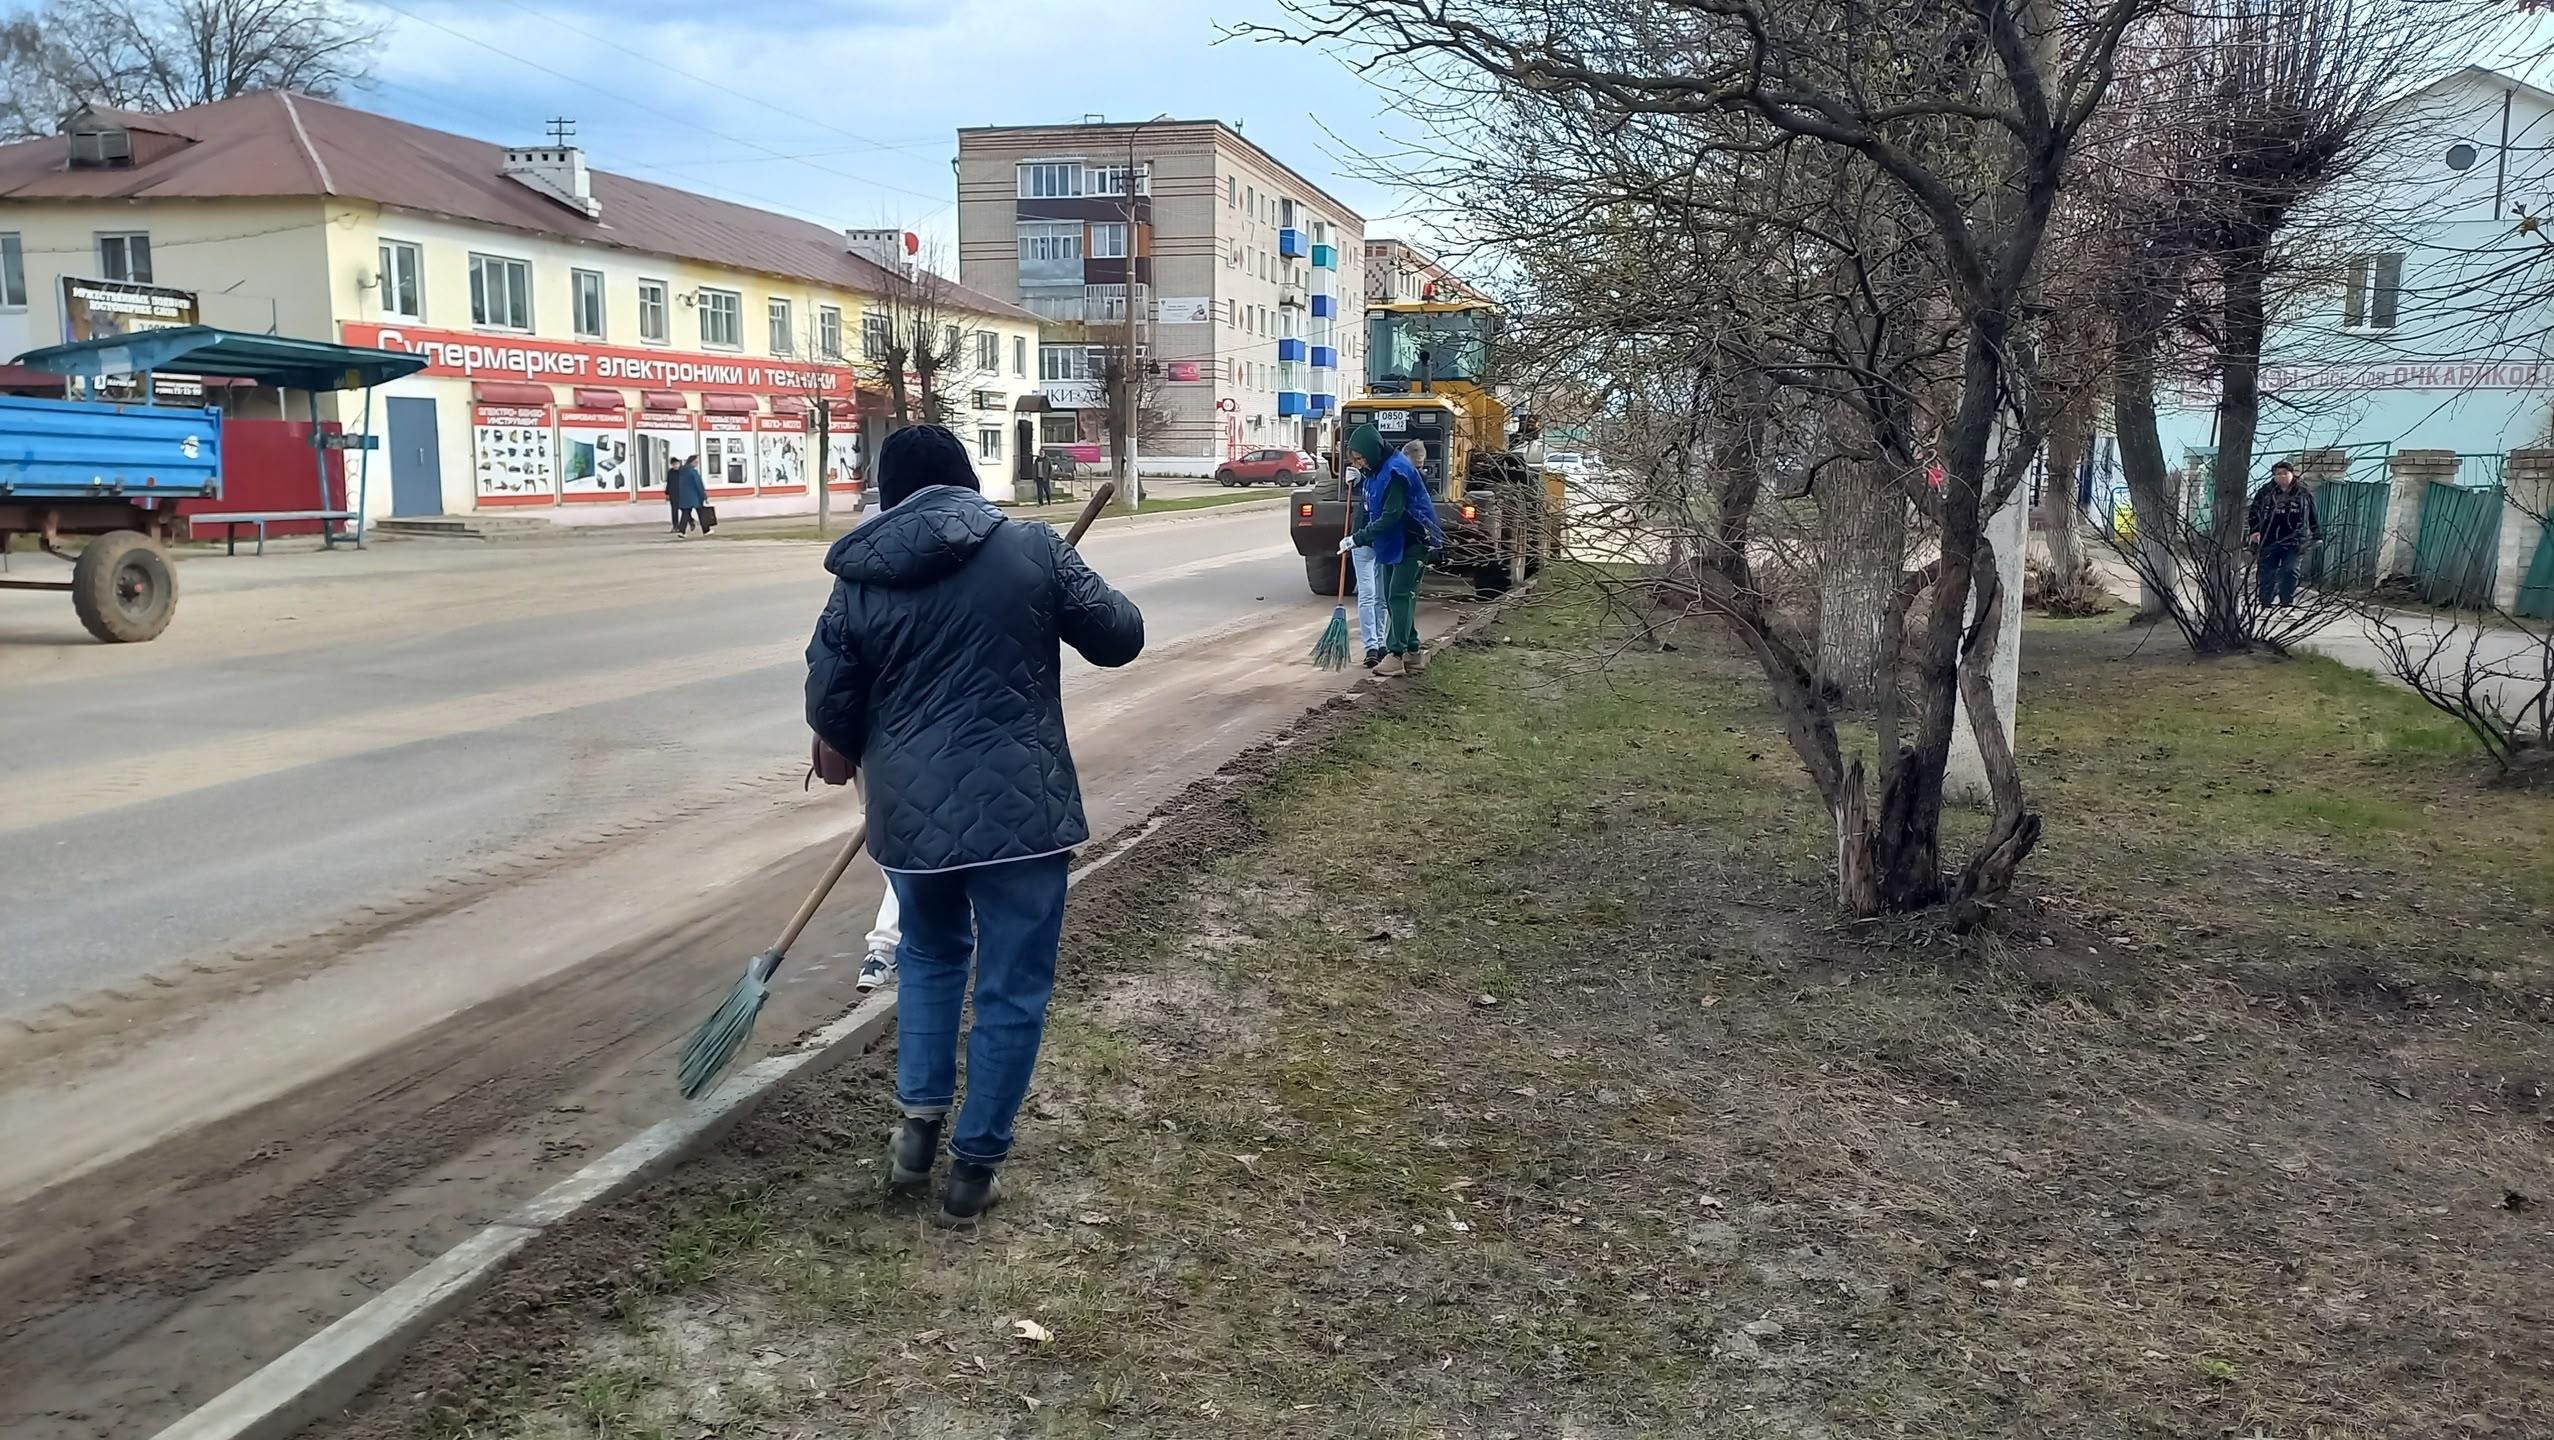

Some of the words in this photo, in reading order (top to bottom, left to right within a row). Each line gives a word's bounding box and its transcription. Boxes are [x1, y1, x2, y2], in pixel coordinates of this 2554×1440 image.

[597, 355, 743, 387] электроники
[748, 368, 760, 386] и
[765, 368, 837, 390] техники
[1382, 411, 1403, 420] 0850
